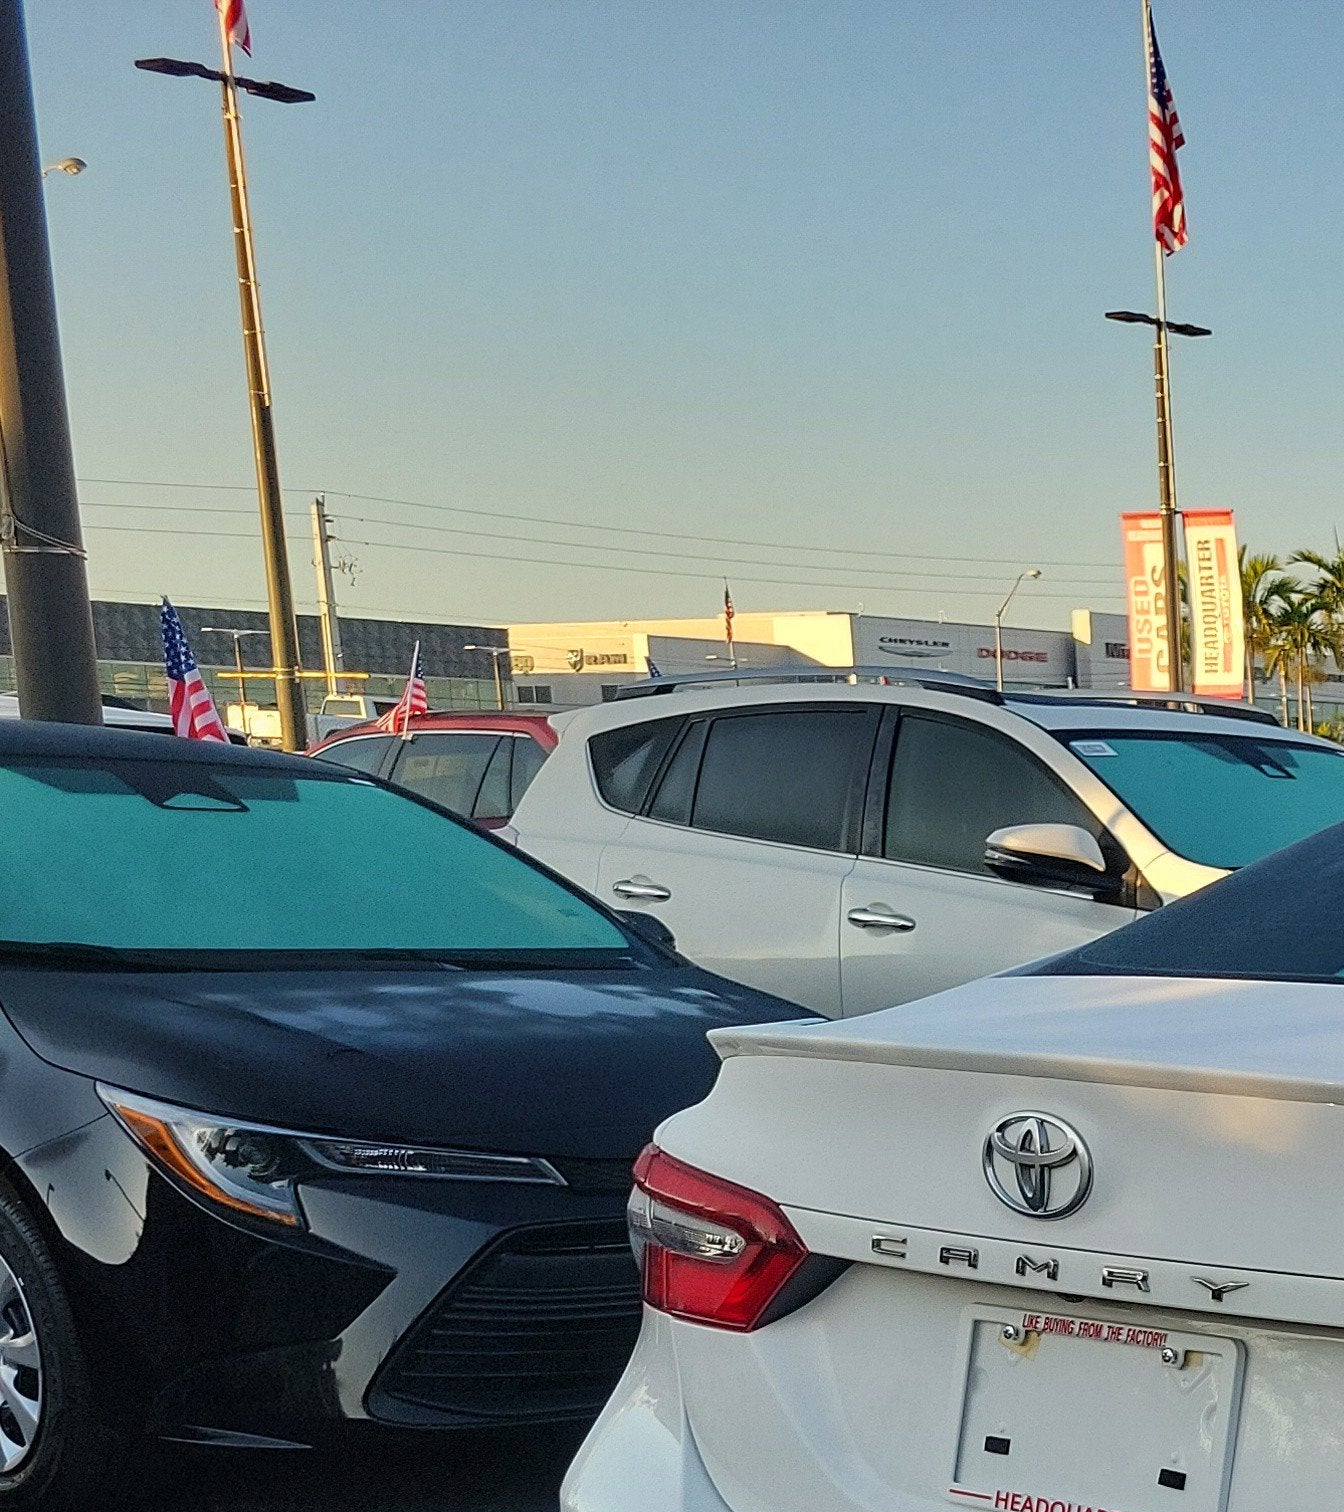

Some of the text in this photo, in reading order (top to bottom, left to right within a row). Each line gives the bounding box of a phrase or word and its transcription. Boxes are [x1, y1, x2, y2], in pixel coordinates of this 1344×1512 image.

[1134, 578, 1152, 656] USED
[1196, 539, 1221, 673] HEADQUARTER
[585, 653, 628, 666] RAM
[879, 636, 950, 648] CHRYSLER
[871, 1234, 1250, 1302] CAMRY
[1022, 1313, 1168, 1348] LIKE BUYING FROM THE FACTORY!
